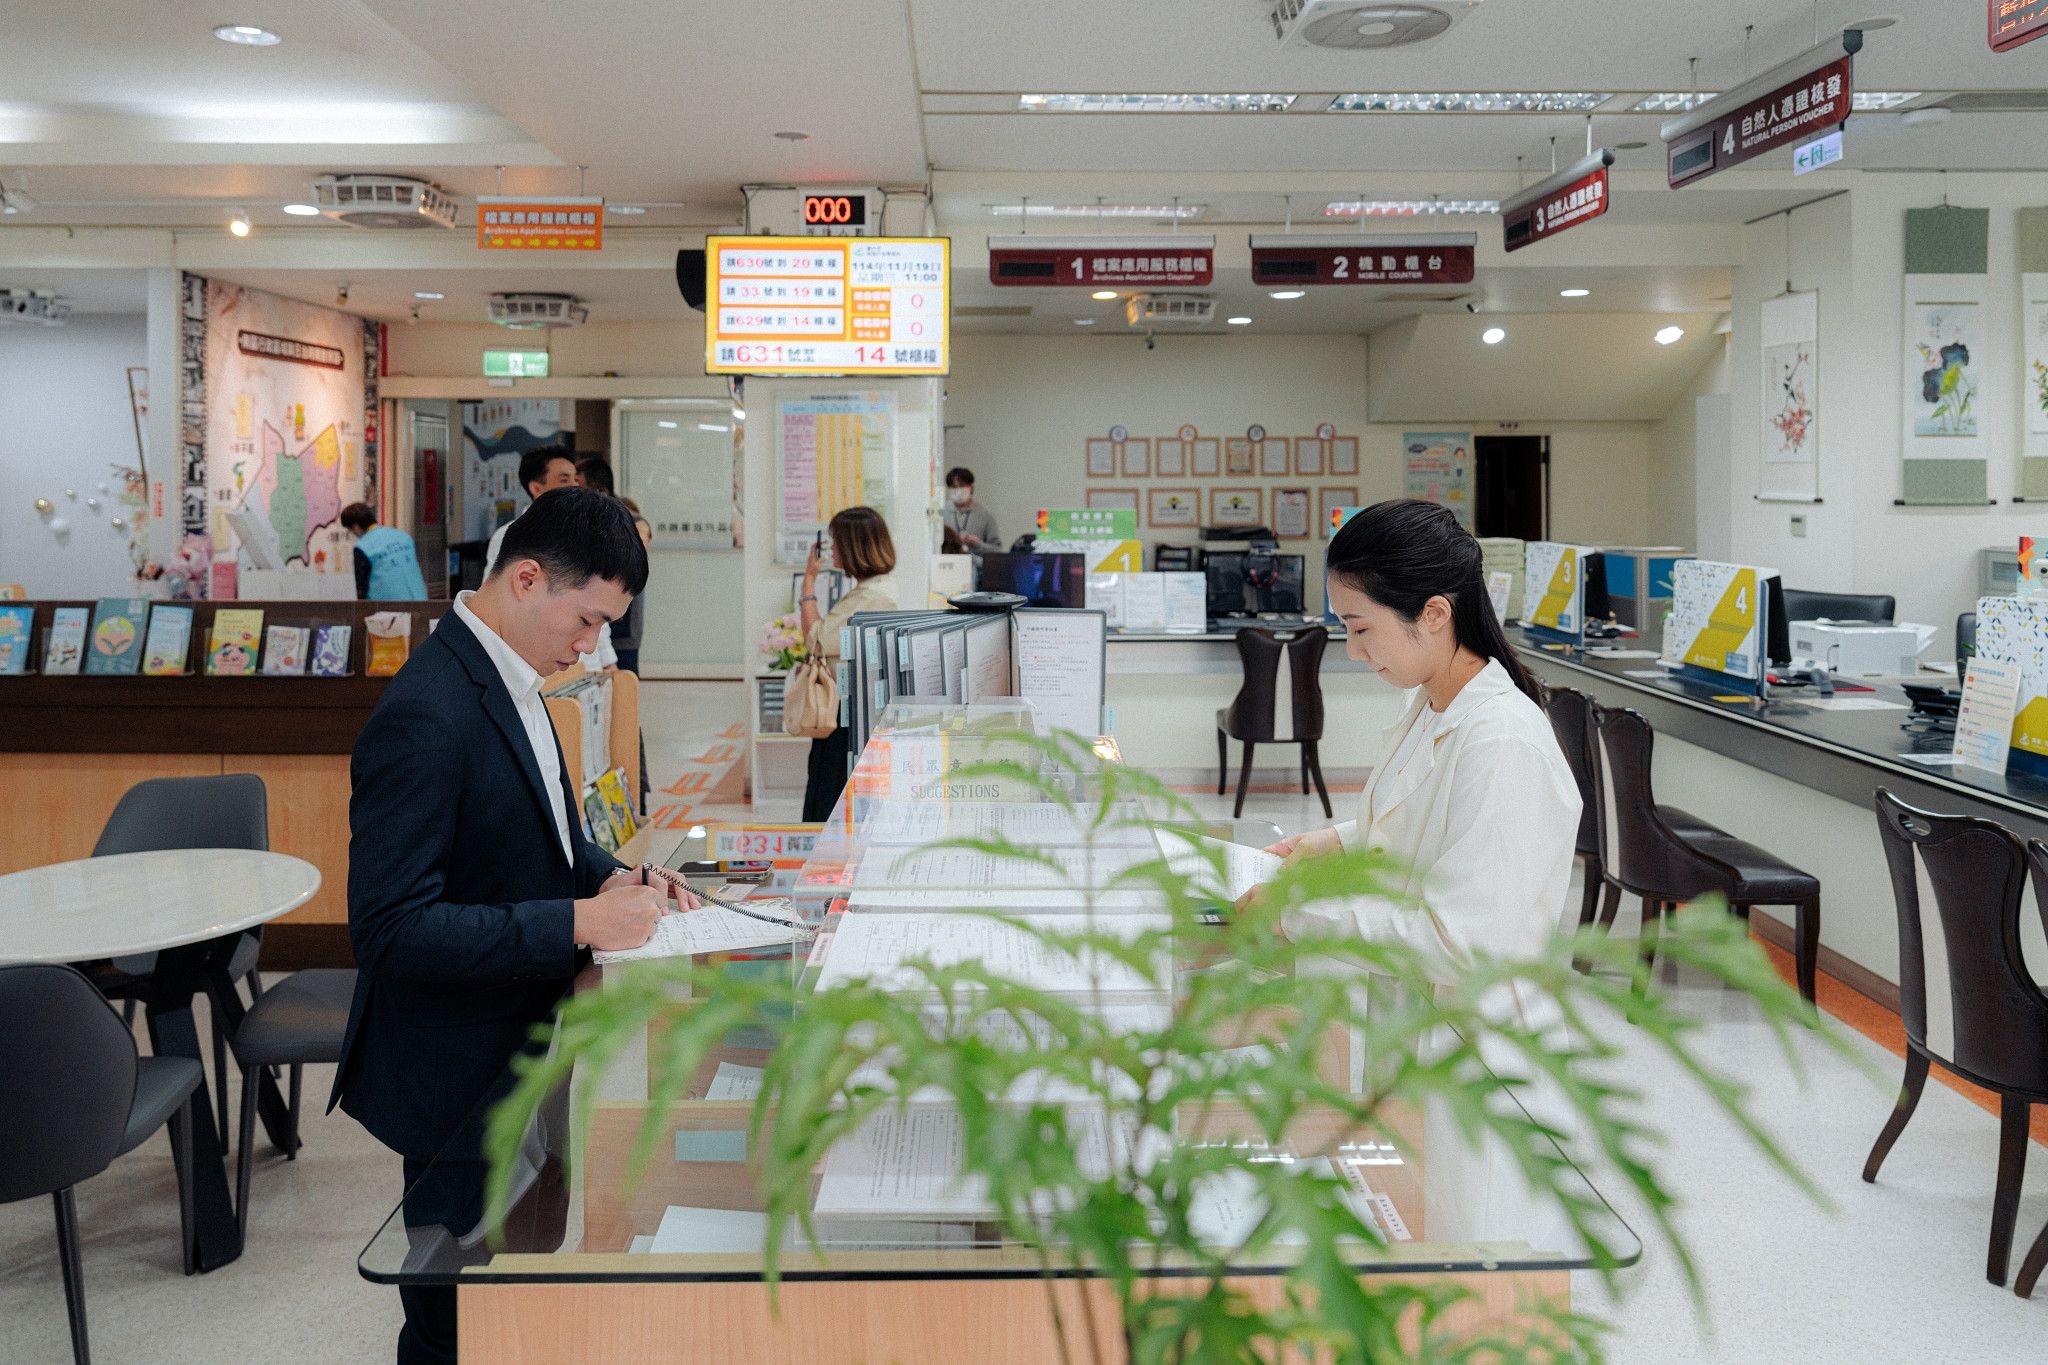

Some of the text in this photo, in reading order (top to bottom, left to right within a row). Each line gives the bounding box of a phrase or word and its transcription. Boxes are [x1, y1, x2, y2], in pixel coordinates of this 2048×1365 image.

[1722, 73, 1842, 155] 4 自然人憑證核發
[1741, 101, 1835, 150] NATURAL PERSON VOUCHER
[805, 197, 851, 223] 000
[1536, 207, 1545, 232] 3
[1070, 257, 1084, 280] 1
[1332, 255, 1443, 279] 2 機動櫃台
[1358, 271, 1423, 280] MOBILE COUNTER
[910, 293, 924, 309] 0
[910, 321, 924, 337] 0
[1563, 561, 1572, 584] 3
[1735, 586, 1747, 615] 4
[911, 784, 1000, 800] SUGGESTIONS
